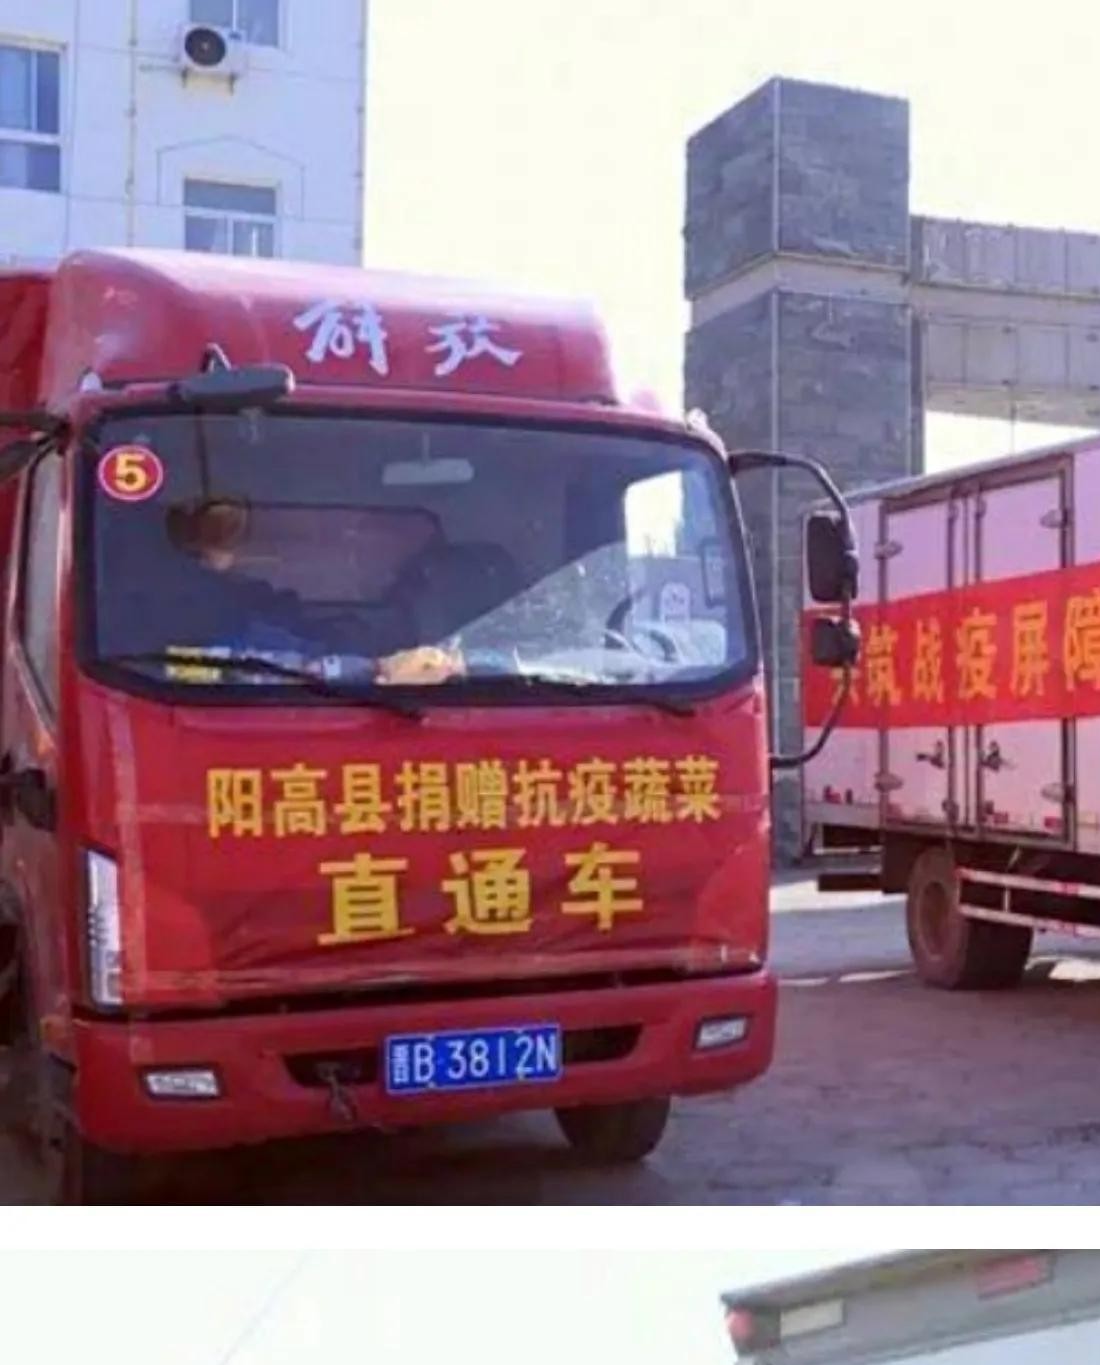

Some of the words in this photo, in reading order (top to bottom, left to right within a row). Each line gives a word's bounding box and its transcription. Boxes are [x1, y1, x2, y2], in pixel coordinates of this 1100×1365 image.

[115, 452, 148, 492] 5
[206, 755, 723, 839] 阳高县捐赠抗疫蔬菜
[317, 841, 644, 946] 直通车
